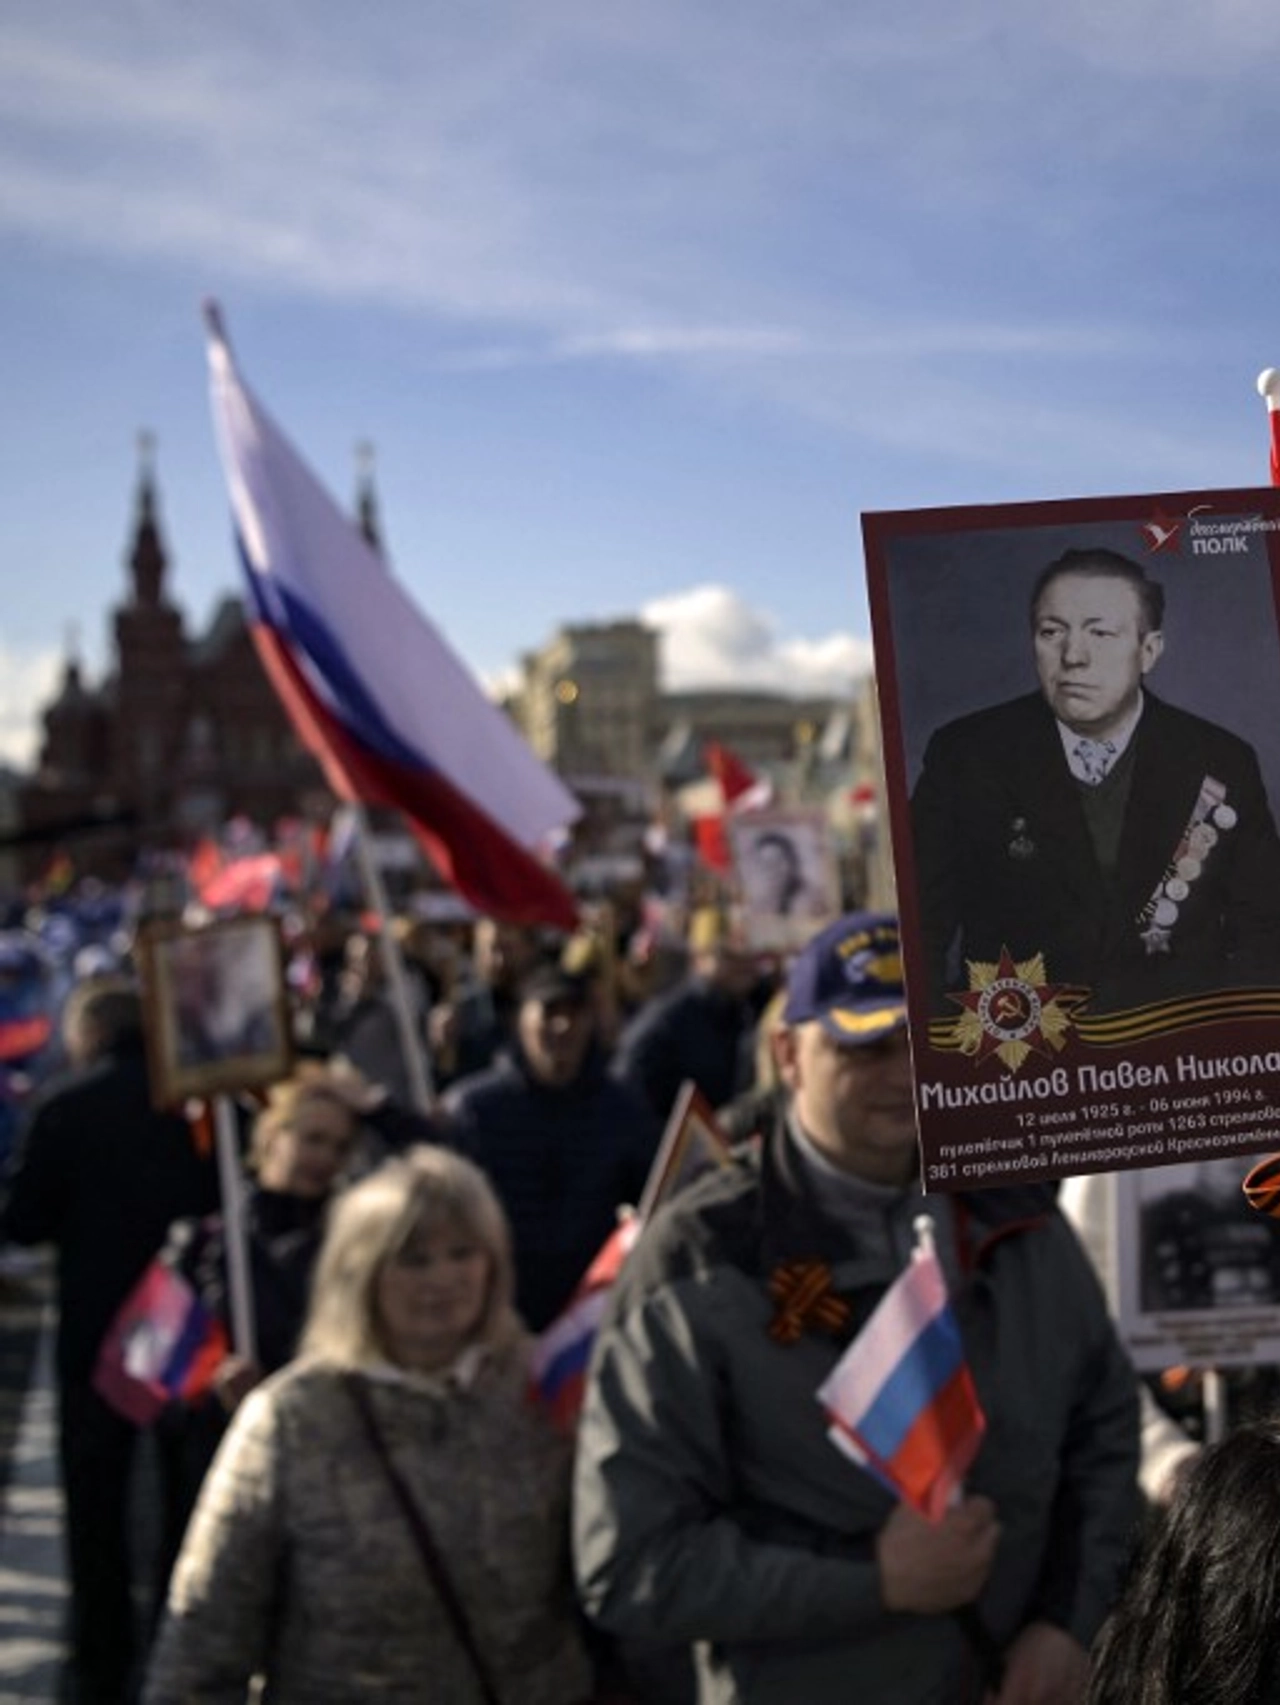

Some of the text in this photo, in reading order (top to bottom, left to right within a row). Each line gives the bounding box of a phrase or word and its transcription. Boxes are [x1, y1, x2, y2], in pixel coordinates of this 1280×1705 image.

[1192, 536, 1249, 555] ПОЛК
[921, 1068, 1068, 1110] Михайлов
[1078, 1061, 1169, 1092] Павел
[1017, 1113, 1035, 1126] 12
[1081, 1103, 1119, 1119] 1925
[1150, 1098, 1169, 1112] 06
[1214, 1089, 1251, 1104] 1994
[1028, 1134, 1035, 1146] 1
[1169, 1113, 1206, 1130] 1263
[929, 1163, 956, 1179] 381
